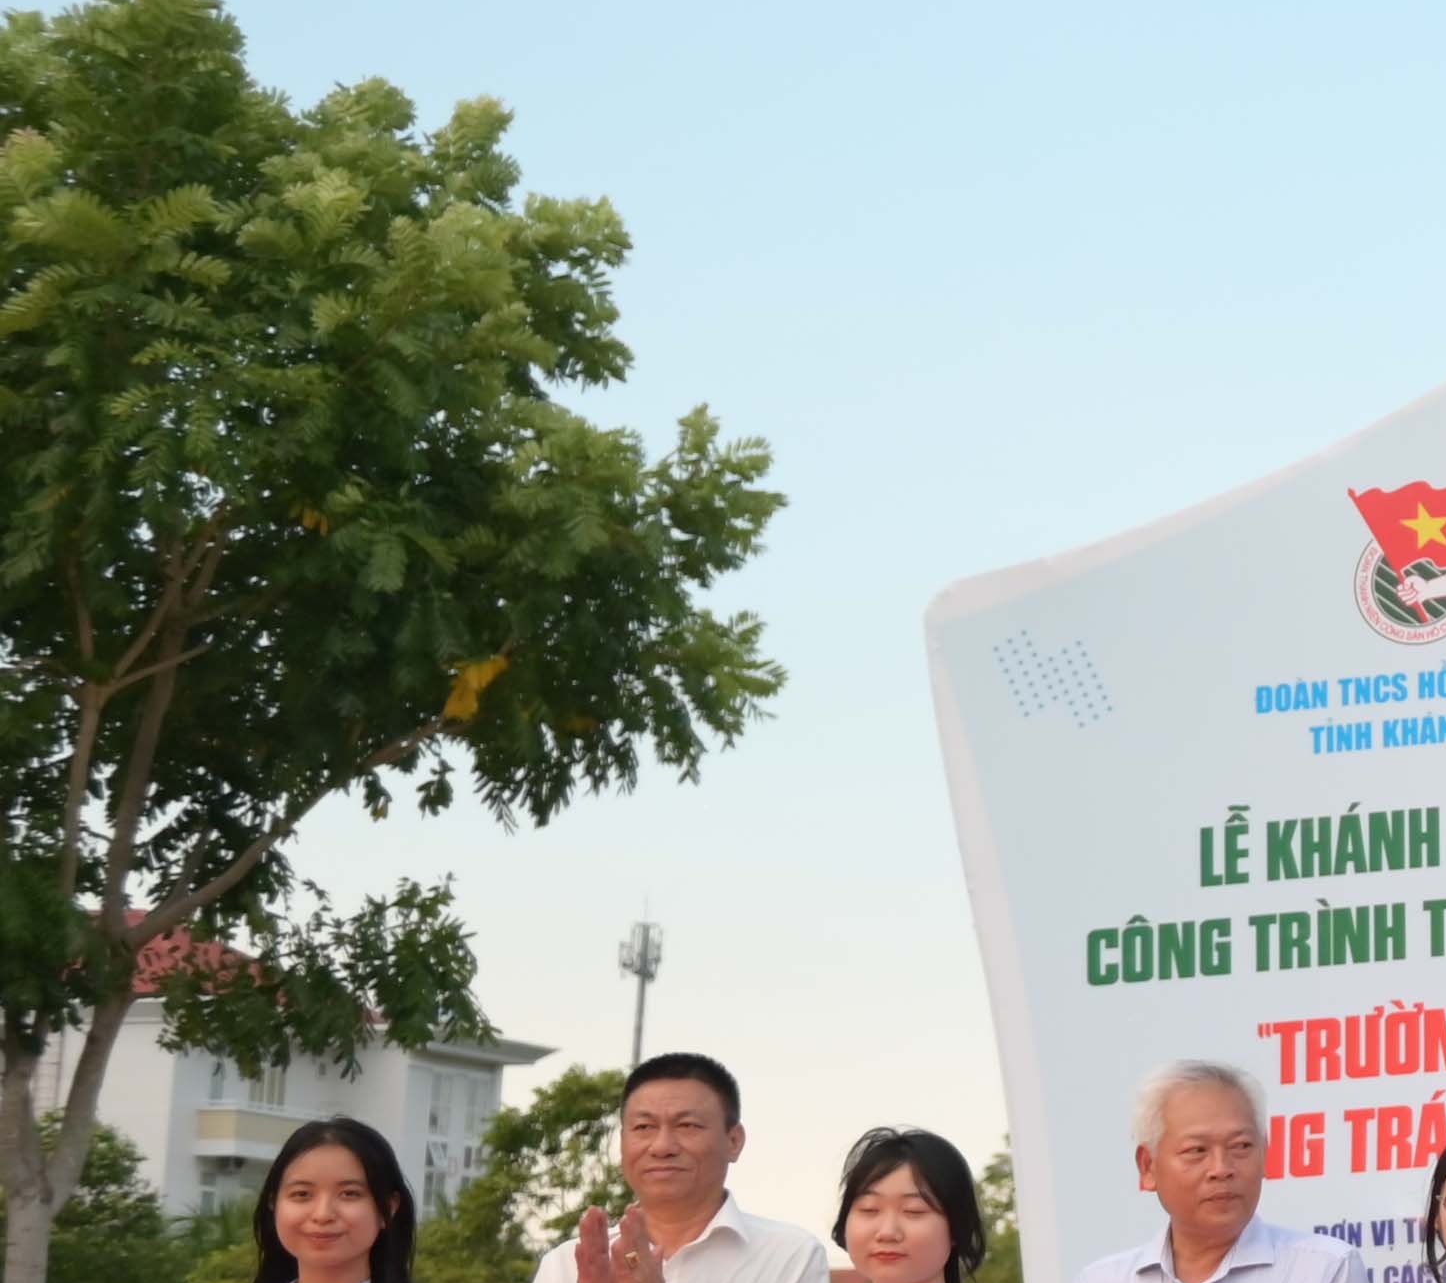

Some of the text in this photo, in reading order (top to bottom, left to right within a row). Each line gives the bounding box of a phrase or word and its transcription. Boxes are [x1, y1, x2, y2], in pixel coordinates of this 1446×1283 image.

[1255, 678, 1328, 714] ĐOÀN
[1338, 673, 1407, 707] TNCS
[1199, 805, 1250, 888] LỄ
[1267, 802, 1440, 882] KHÁNH
[1087, 915, 1232, 986] CÔNG
[1248, 899, 1406, 973] TRÌNH
[1371, 1219, 1395, 1251] VỊ
